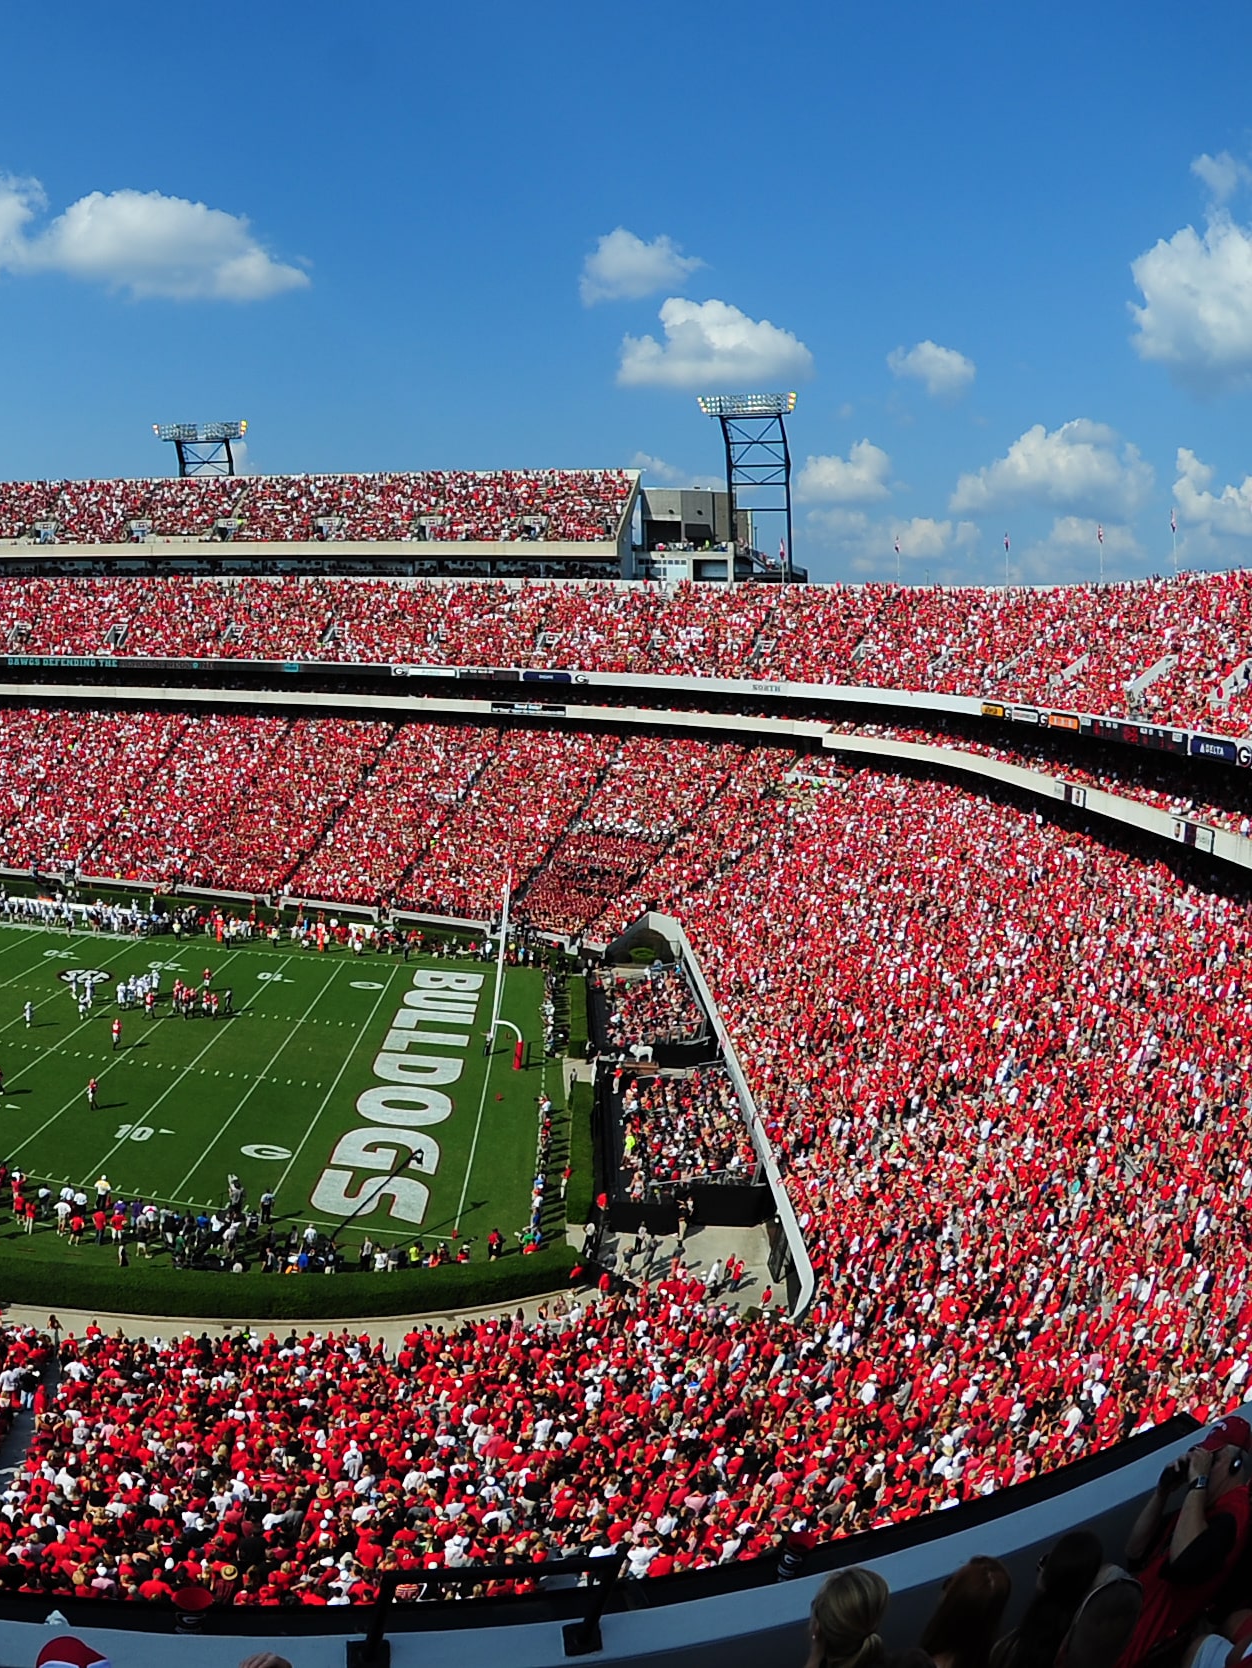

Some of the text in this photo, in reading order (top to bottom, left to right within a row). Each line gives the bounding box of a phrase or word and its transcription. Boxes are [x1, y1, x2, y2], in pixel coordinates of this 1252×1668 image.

[7, 658, 40, 666] DAWGS
[43, 658, 96, 667] DEFENDING
[99, 659, 118, 668] THE
[752, 684, 781, 692] NORTH
[1205, 743, 1224, 757] DELTA
[310, 968, 485, 1225] BULLDOGS
[114, 1123, 155, 1141] 10
[240, 1143, 293, 1160] G
